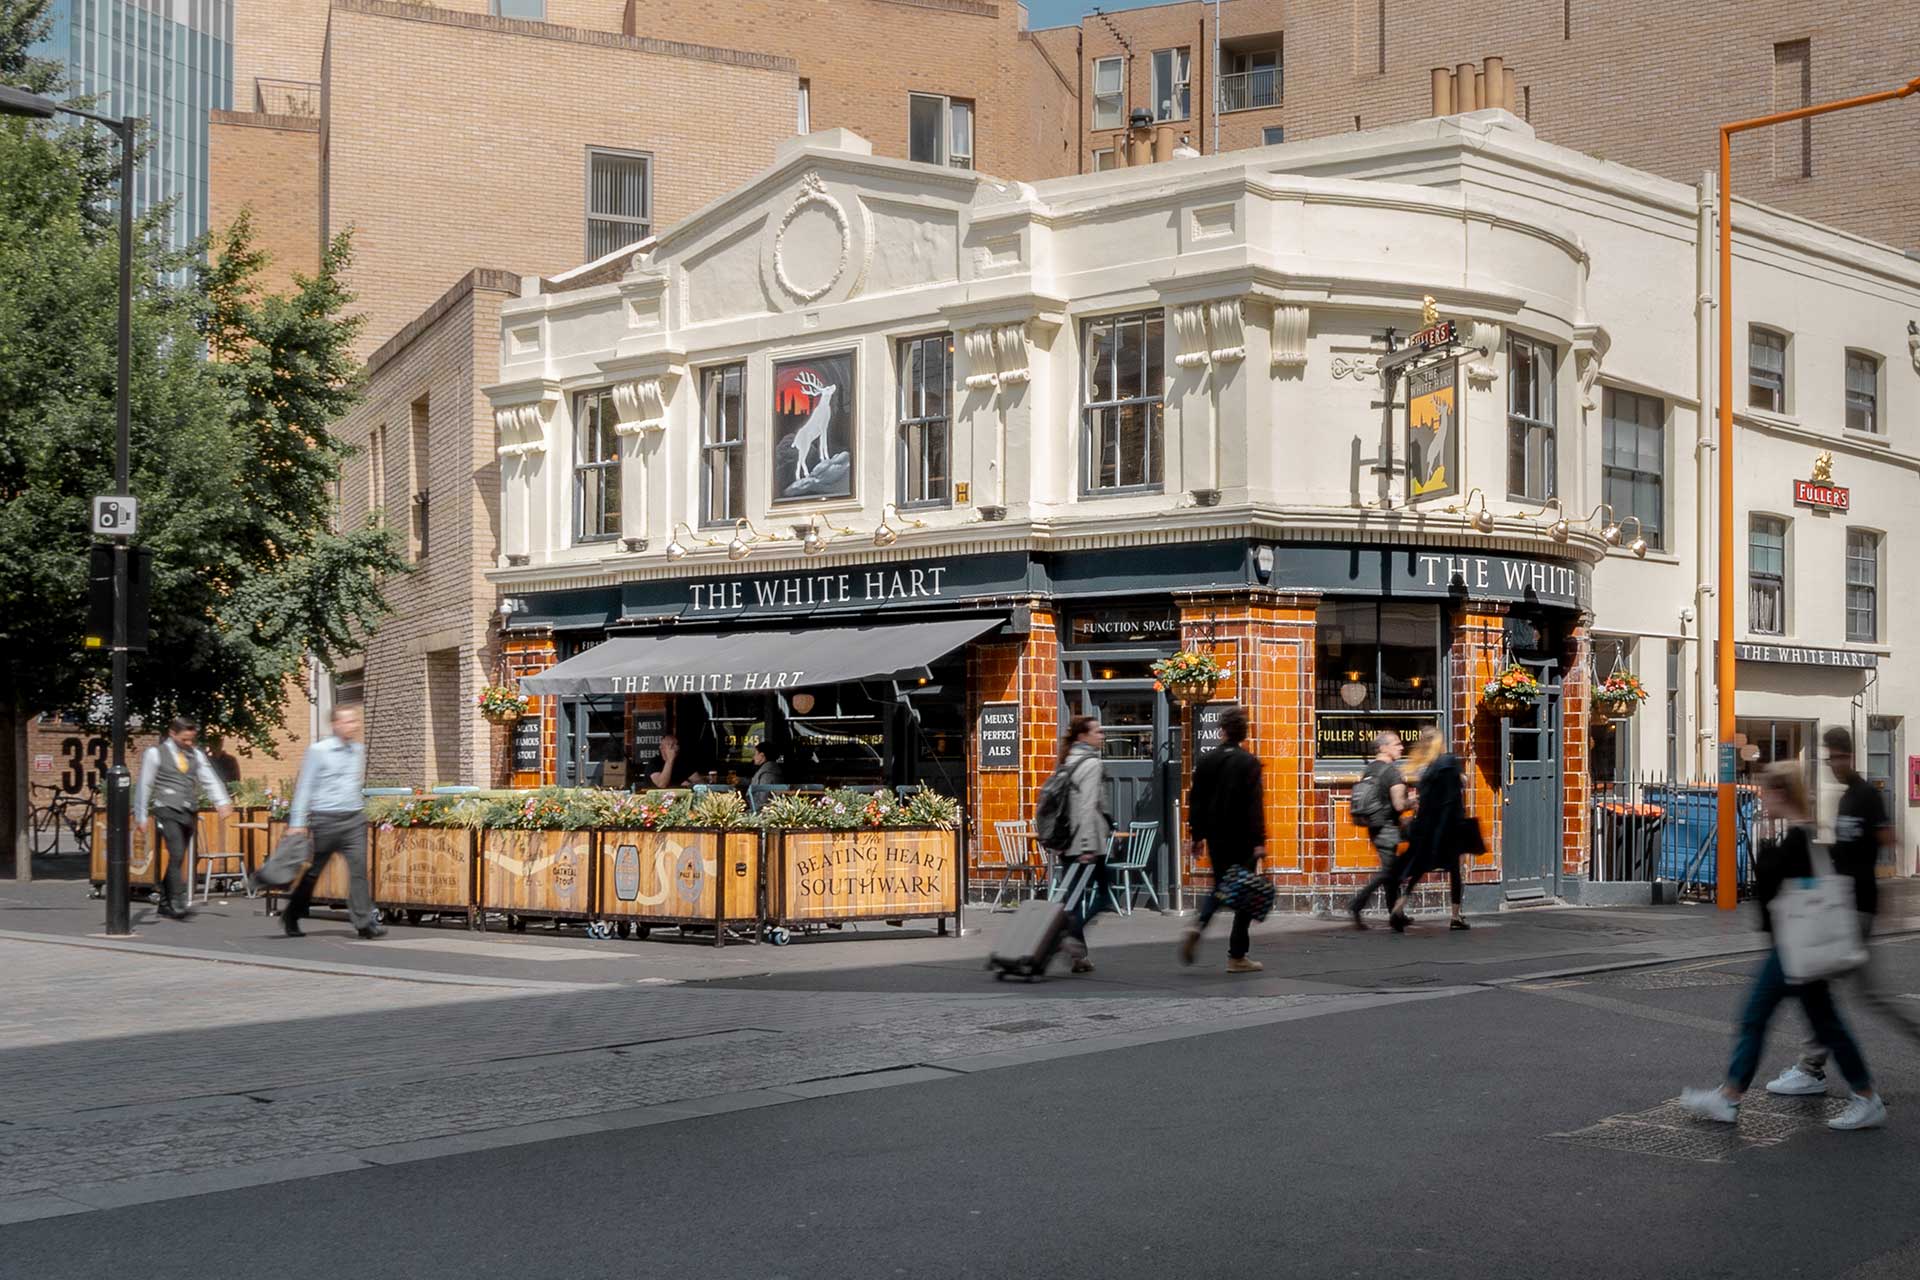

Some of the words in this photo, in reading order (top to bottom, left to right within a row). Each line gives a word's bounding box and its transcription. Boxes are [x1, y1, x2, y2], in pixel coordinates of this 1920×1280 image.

[1425, 368, 1438, 381] THE
[1800, 484, 1847, 505] FULLER'S
[1419, 556, 1489, 588] THE
[1501, 560, 1576, 597] WHITE
[689, 582, 743, 610] THE
[754, 574, 850, 607] WHITE
[865, 567, 946, 600] HART
[1083, 621, 1139, 634] FUNCTION
[1143, 619, 1175, 632] SPACE
[1742, 645, 1770, 661] THE
[1779, 647, 1825, 664] WHITE
[1832, 651, 1866, 667] HART
[612, 676, 650, 693] THE
[664, 674, 733, 693] WHITE
[744, 671, 804, 690] HART
[985, 713, 1015, 724] MEUX'S
[636, 735, 662, 745] BOTTLE
[982, 730, 1016, 741] PERFECT
[1318, 730, 1354, 741] FULLER
[988, 746, 1011, 756] ALES
[61, 737, 109, 794] 33
[797, 847, 877, 876] BEATING
[886, 847, 948, 872] HEART
[866, 863, 877, 876] of
[800, 876, 941, 896] SOUTHWARK
